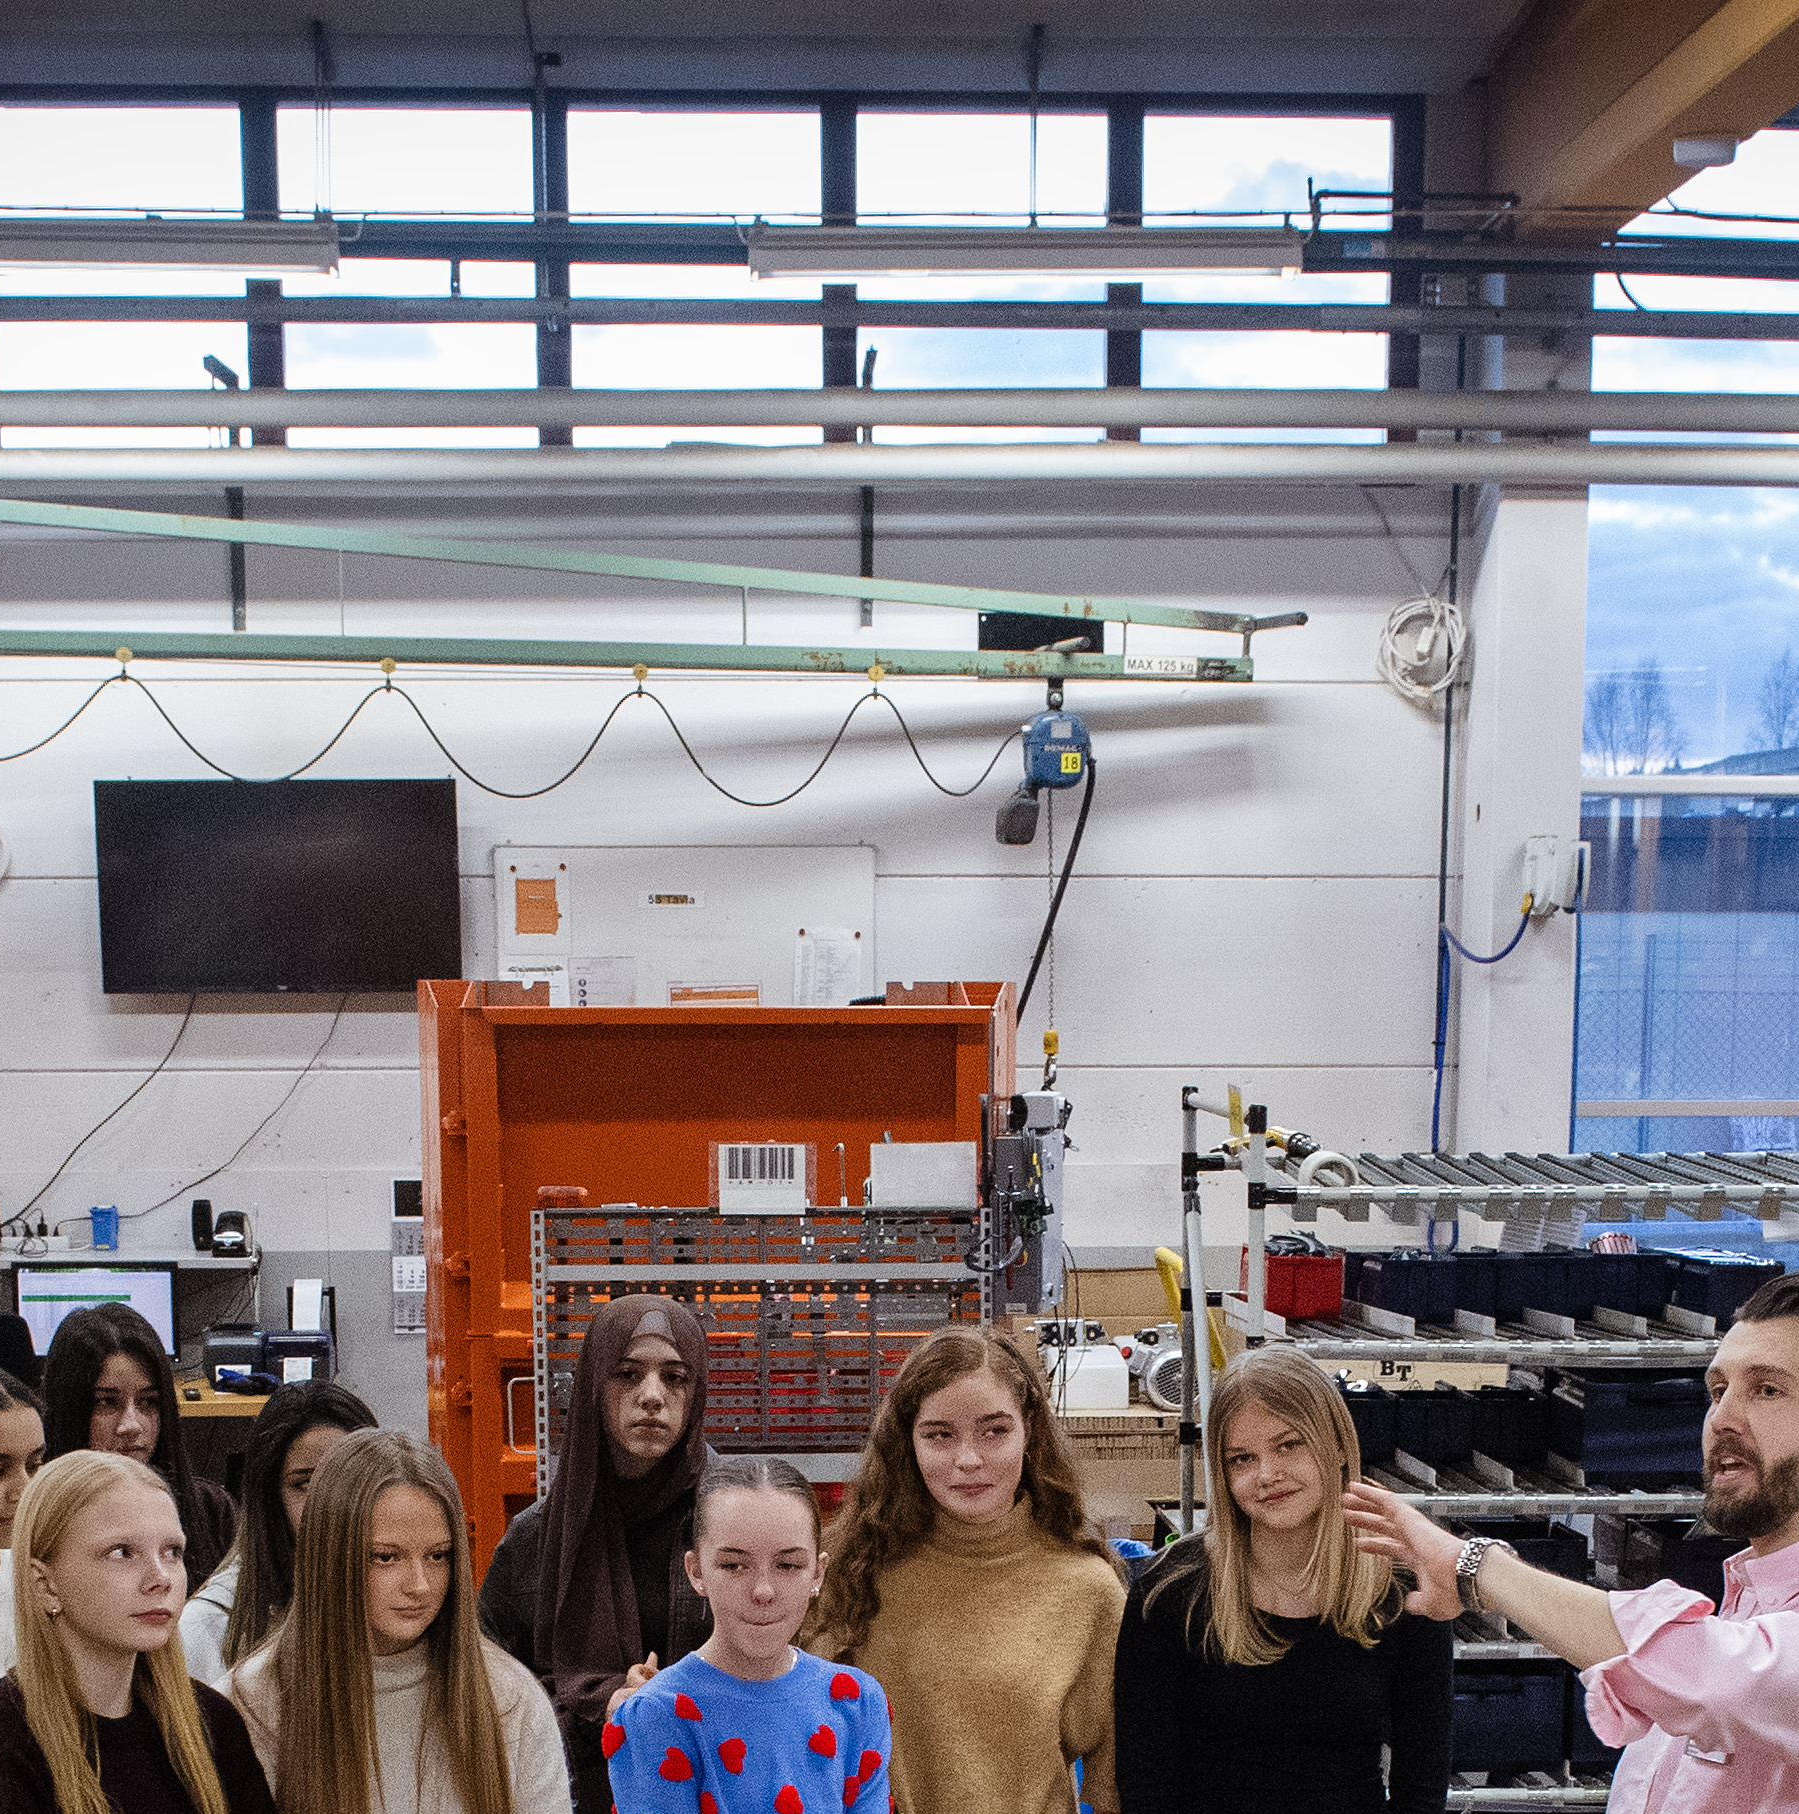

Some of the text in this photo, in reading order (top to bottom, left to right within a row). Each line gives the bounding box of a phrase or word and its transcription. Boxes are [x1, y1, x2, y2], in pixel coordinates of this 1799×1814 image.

[1127, 659, 1195, 675] MAX 125 kg
[1064, 755, 1079, 770] 18
[1380, 1360, 1412, 1381] BT
